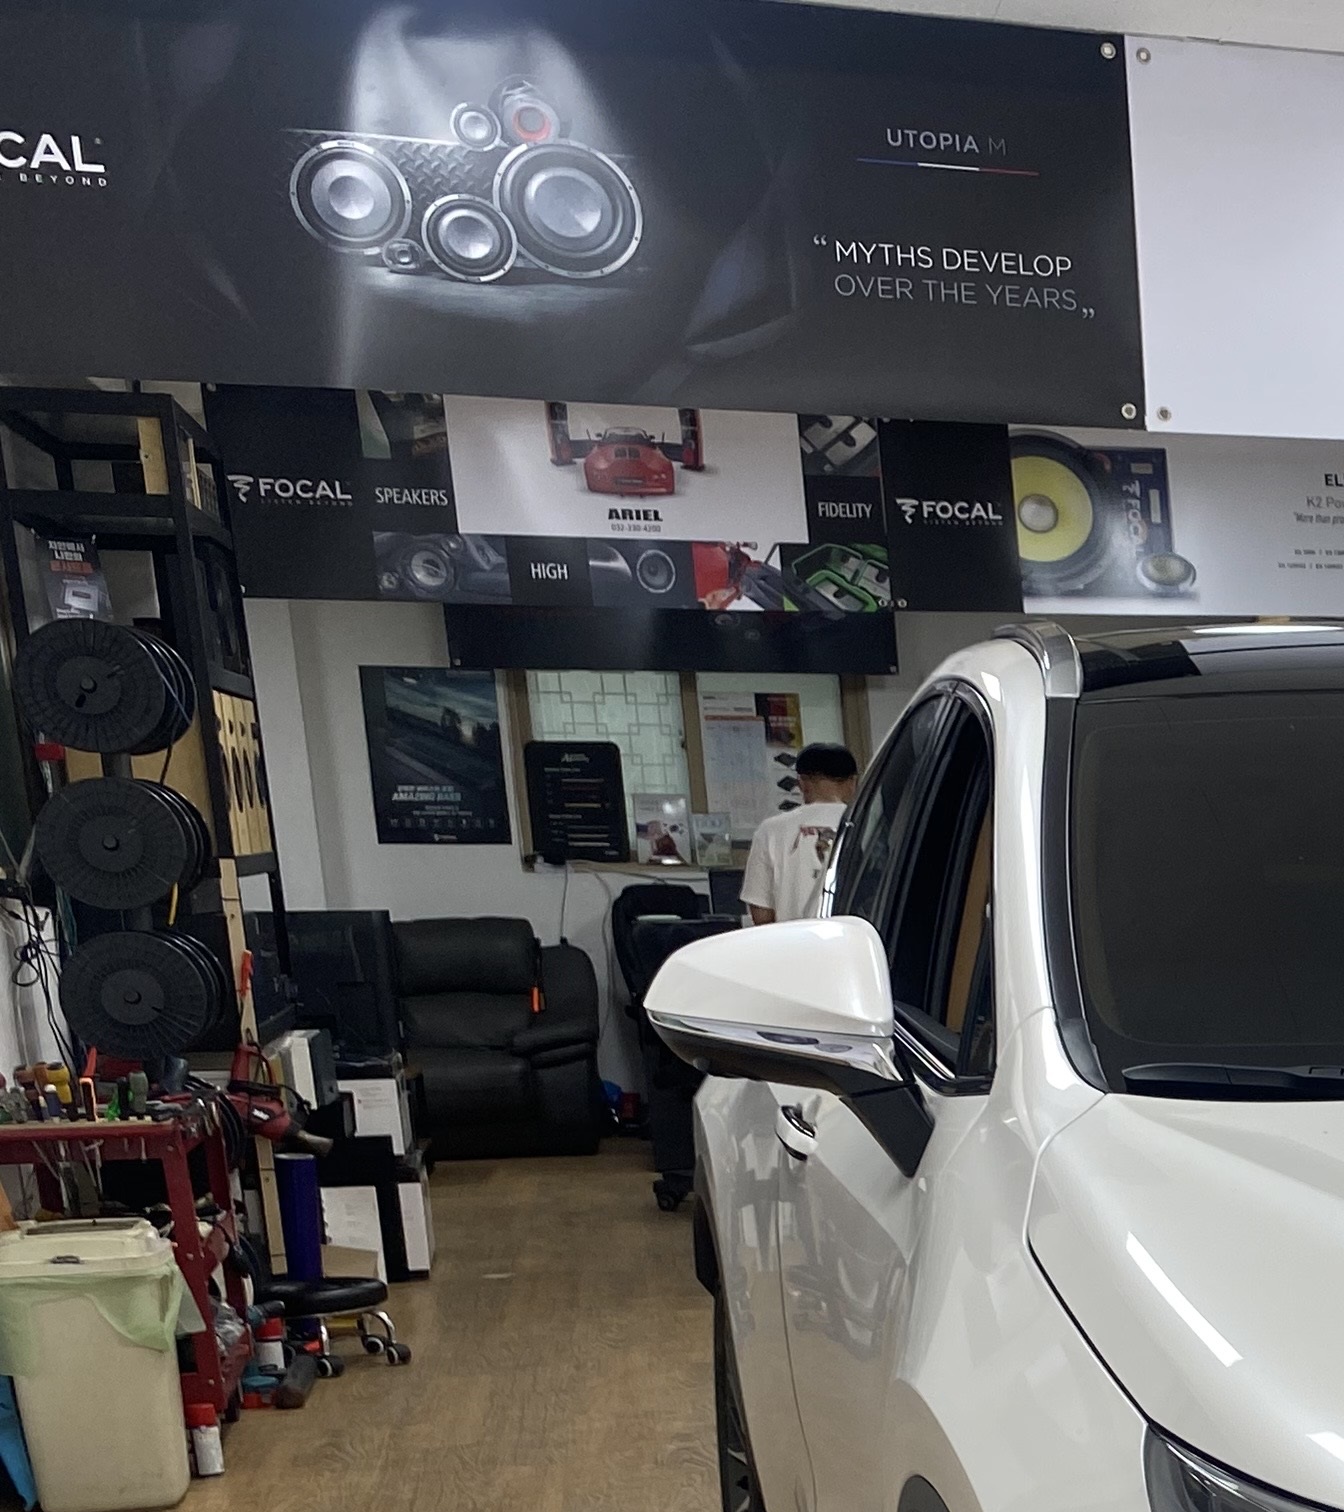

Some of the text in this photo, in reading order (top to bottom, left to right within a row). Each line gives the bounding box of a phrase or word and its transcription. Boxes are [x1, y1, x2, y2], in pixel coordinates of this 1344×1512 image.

[886, 127, 1008, 156] UTOPIA M
[19, 172, 108, 187] BEYOND
[834, 239, 1073, 277] MYTHS DEVELOP
[834, 273, 1078, 312] OVER THE YEARS
[257, 478, 353, 500] FOCAL
[374, 486, 449, 507] SPEAKERS
[817, 501, 873, 519] FIDELITY
[921, 500, 1004, 520] FOCAL
[1306, 495, 1322, 509] K2
[607, 508, 664, 522] ARIEL
[530, 562, 569, 581] HIGH
